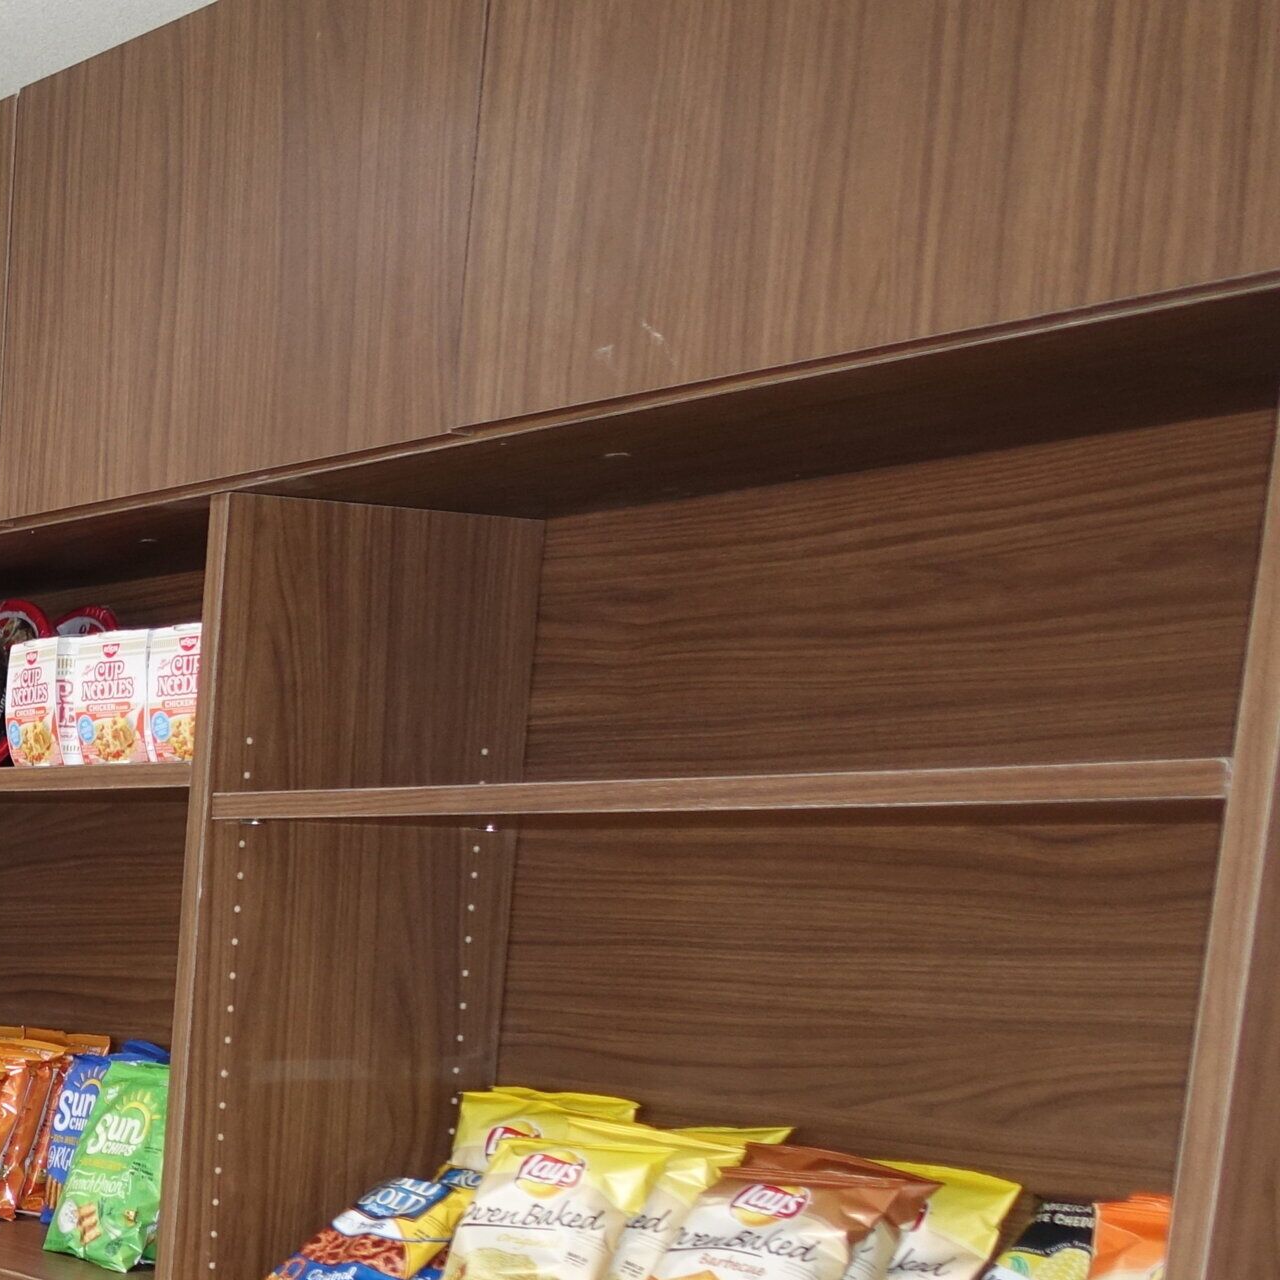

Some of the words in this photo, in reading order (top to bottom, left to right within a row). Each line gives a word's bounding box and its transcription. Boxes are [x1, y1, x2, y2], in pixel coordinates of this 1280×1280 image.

[20, 667, 42, 688] CUP
[94, 660, 125, 681] CUP
[11, 683, 49, 708] NOODLES
[81, 677, 134, 702] NOODLES
[69, 1117, 88, 1132] CHI
[87, 1112, 146, 1155] Sun
[101, 1141, 138, 1157] CHIPS
[522, 1200, 606, 1231] Baked
[726, 1228, 822, 1263] Baked
[699, 1252, 766, 1277] Barbecue
